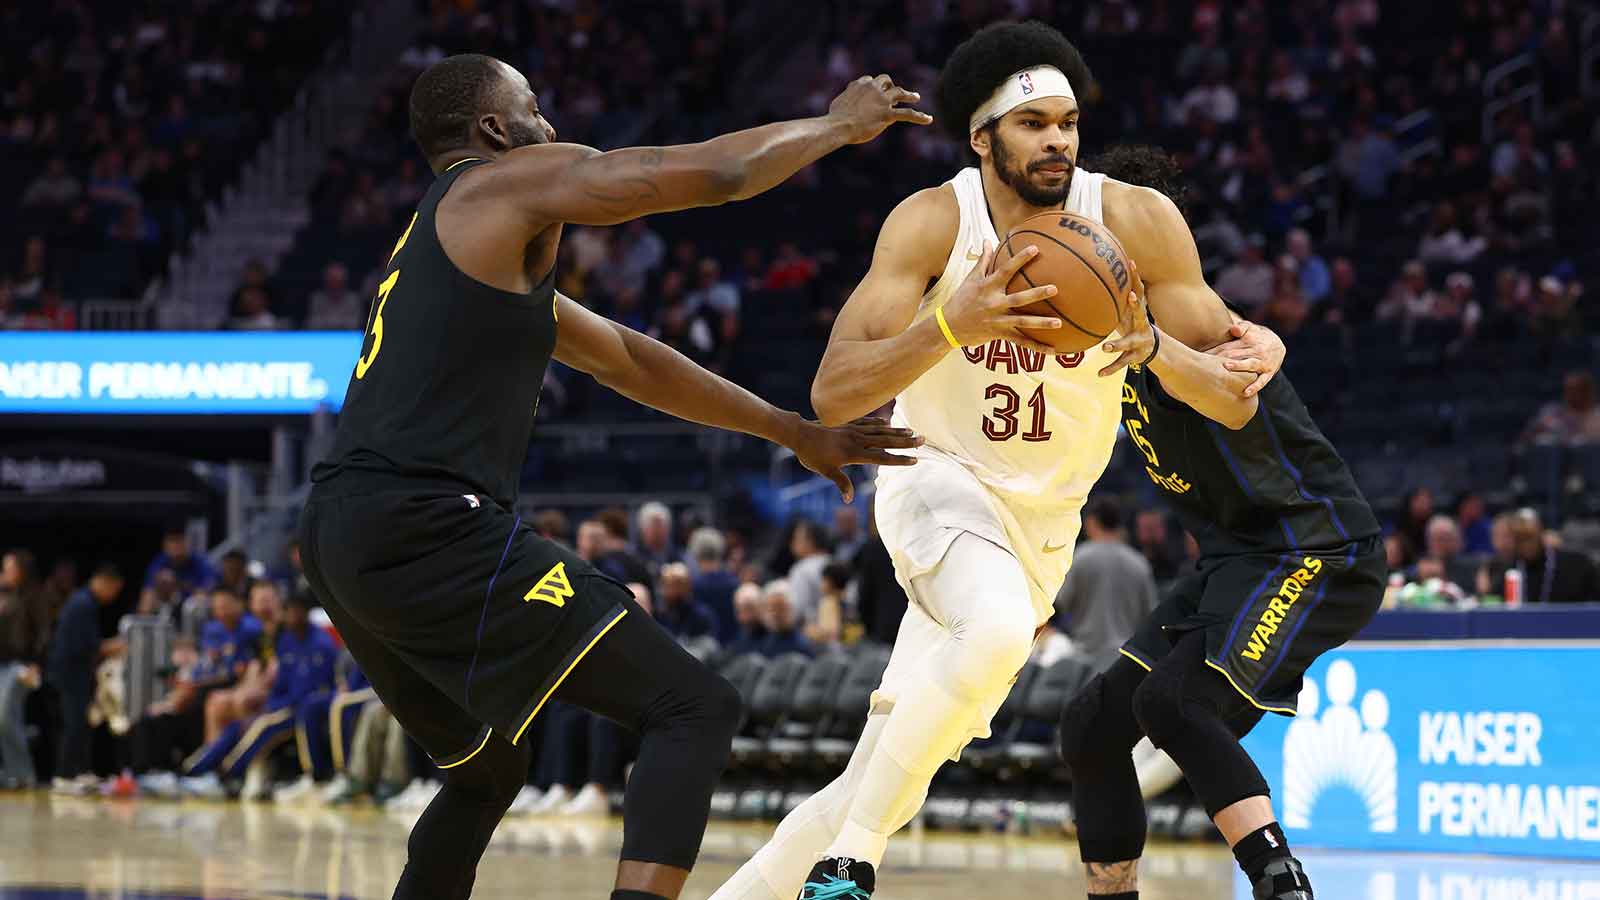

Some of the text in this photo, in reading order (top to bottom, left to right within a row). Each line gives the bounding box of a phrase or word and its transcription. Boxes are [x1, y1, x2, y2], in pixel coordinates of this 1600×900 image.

[1057, 216, 1129, 293] Wilson
[355, 269, 401, 380] 3
[981, 381, 1053, 442] 31
[1240, 556, 1323, 662] WARRIORS
[1419, 711, 1542, 767] KAISER
[1418, 782, 1600, 840] PERMANE
